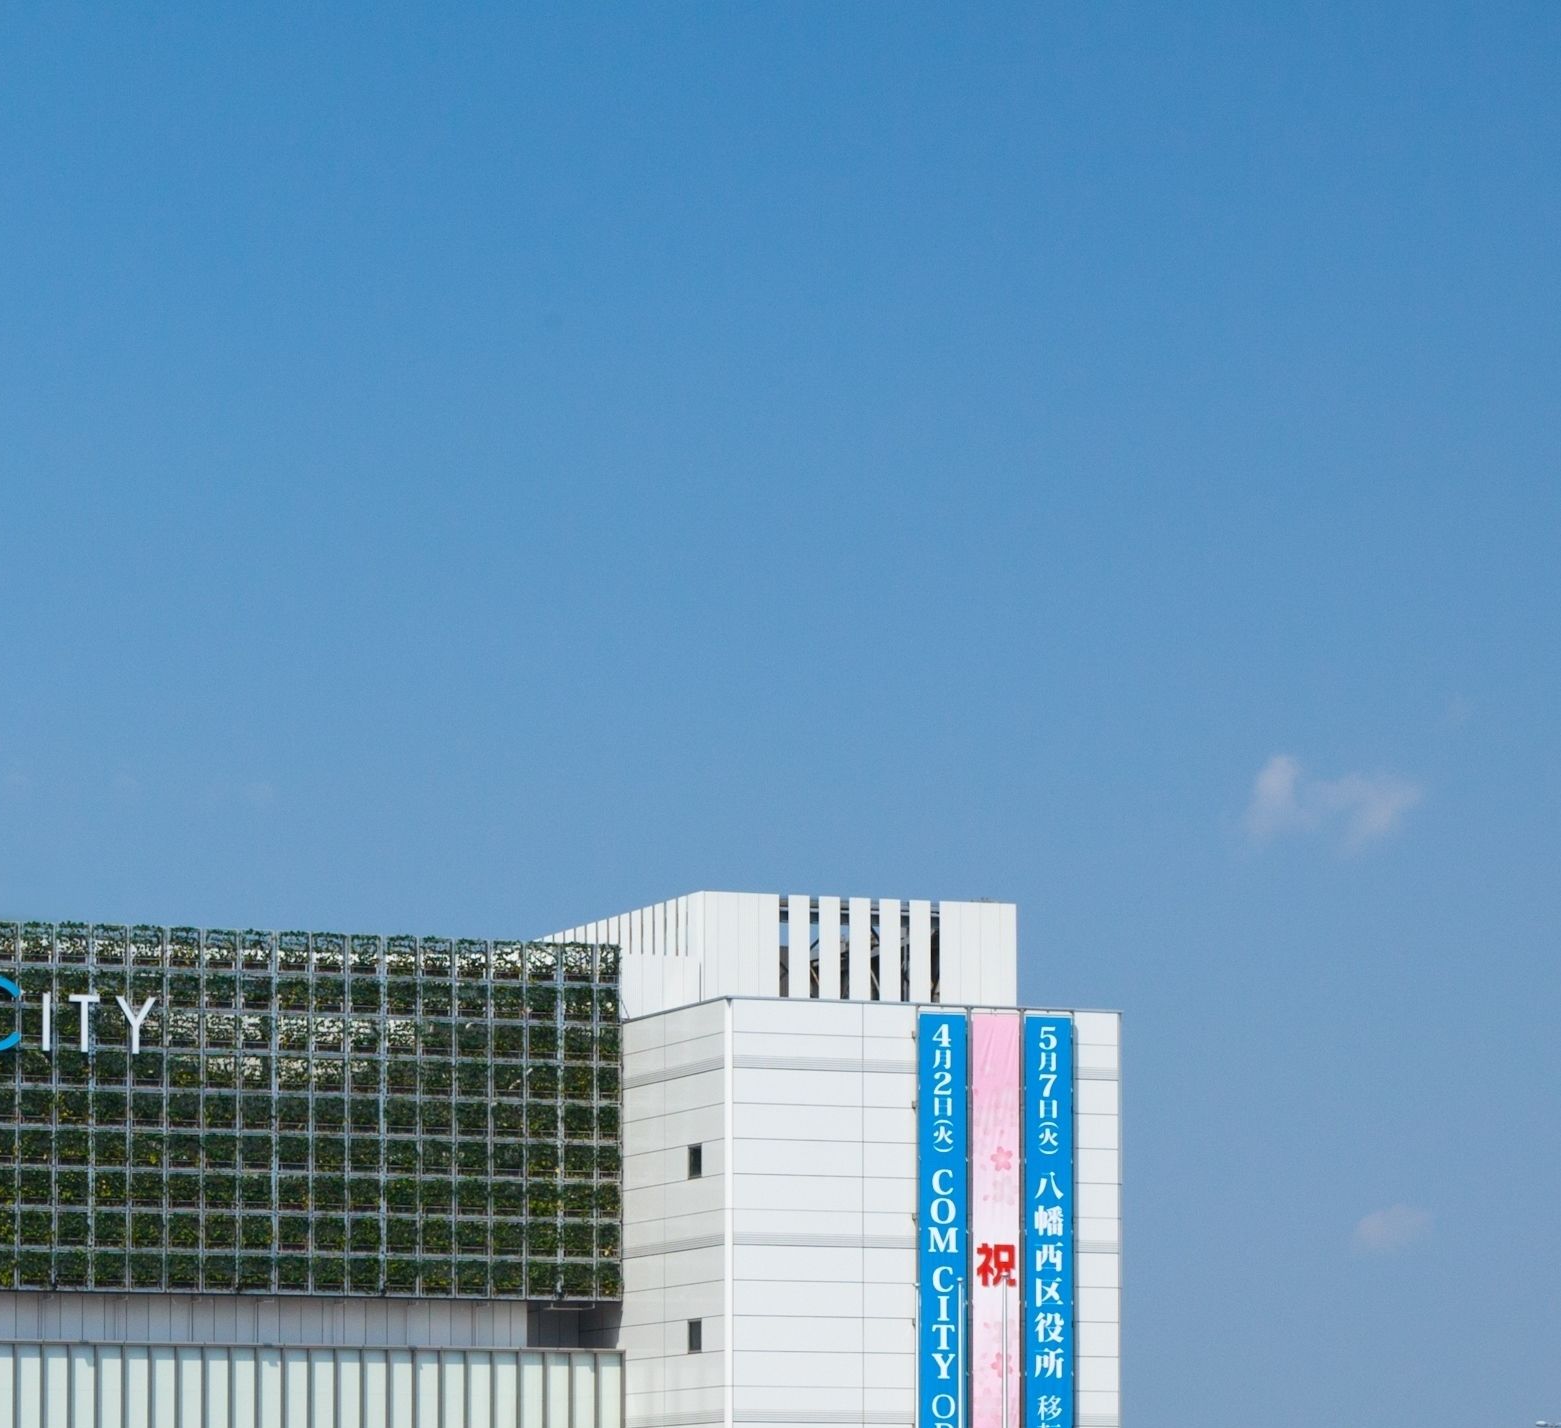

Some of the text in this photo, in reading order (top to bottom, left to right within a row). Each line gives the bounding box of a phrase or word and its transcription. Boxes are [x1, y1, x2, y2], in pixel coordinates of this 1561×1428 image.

[928, 1169, 958, 1253] COM
[977, 1243, 1017, 1287] 祝
[1034, 1172, 1065, 1378] 八幡西区役所
[932, 1266, 955, 1379] CITY
